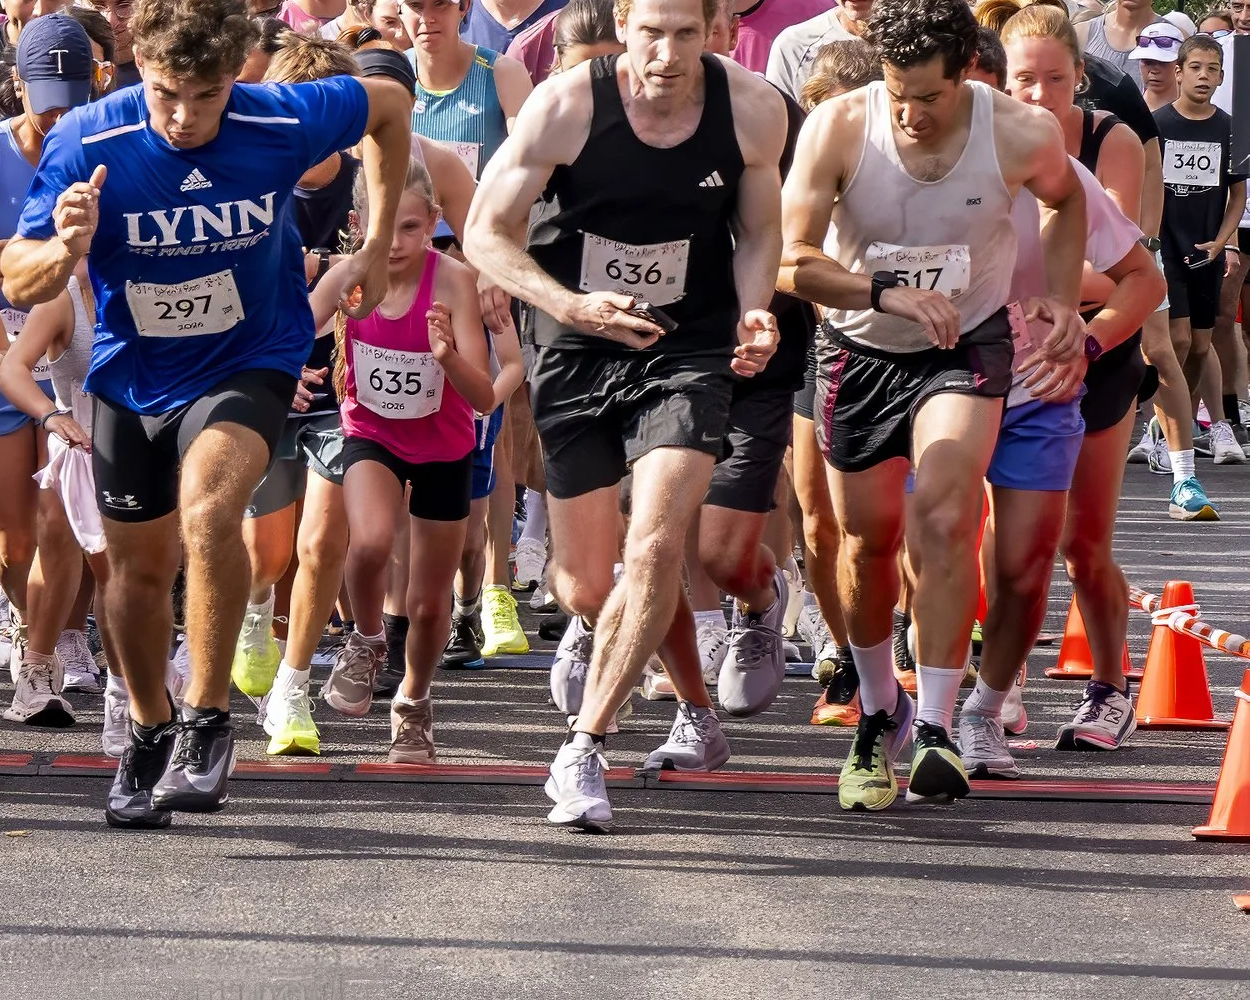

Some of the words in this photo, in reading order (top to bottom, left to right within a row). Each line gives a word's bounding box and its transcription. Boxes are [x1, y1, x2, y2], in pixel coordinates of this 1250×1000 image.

[48, 49, 69, 74] T
[1173, 153, 1211, 170] 340
[123, 191, 277, 247] LYNN
[606, 258, 662, 285] 636
[154, 294, 212, 320] 297
[370, 367, 422, 396] 635
